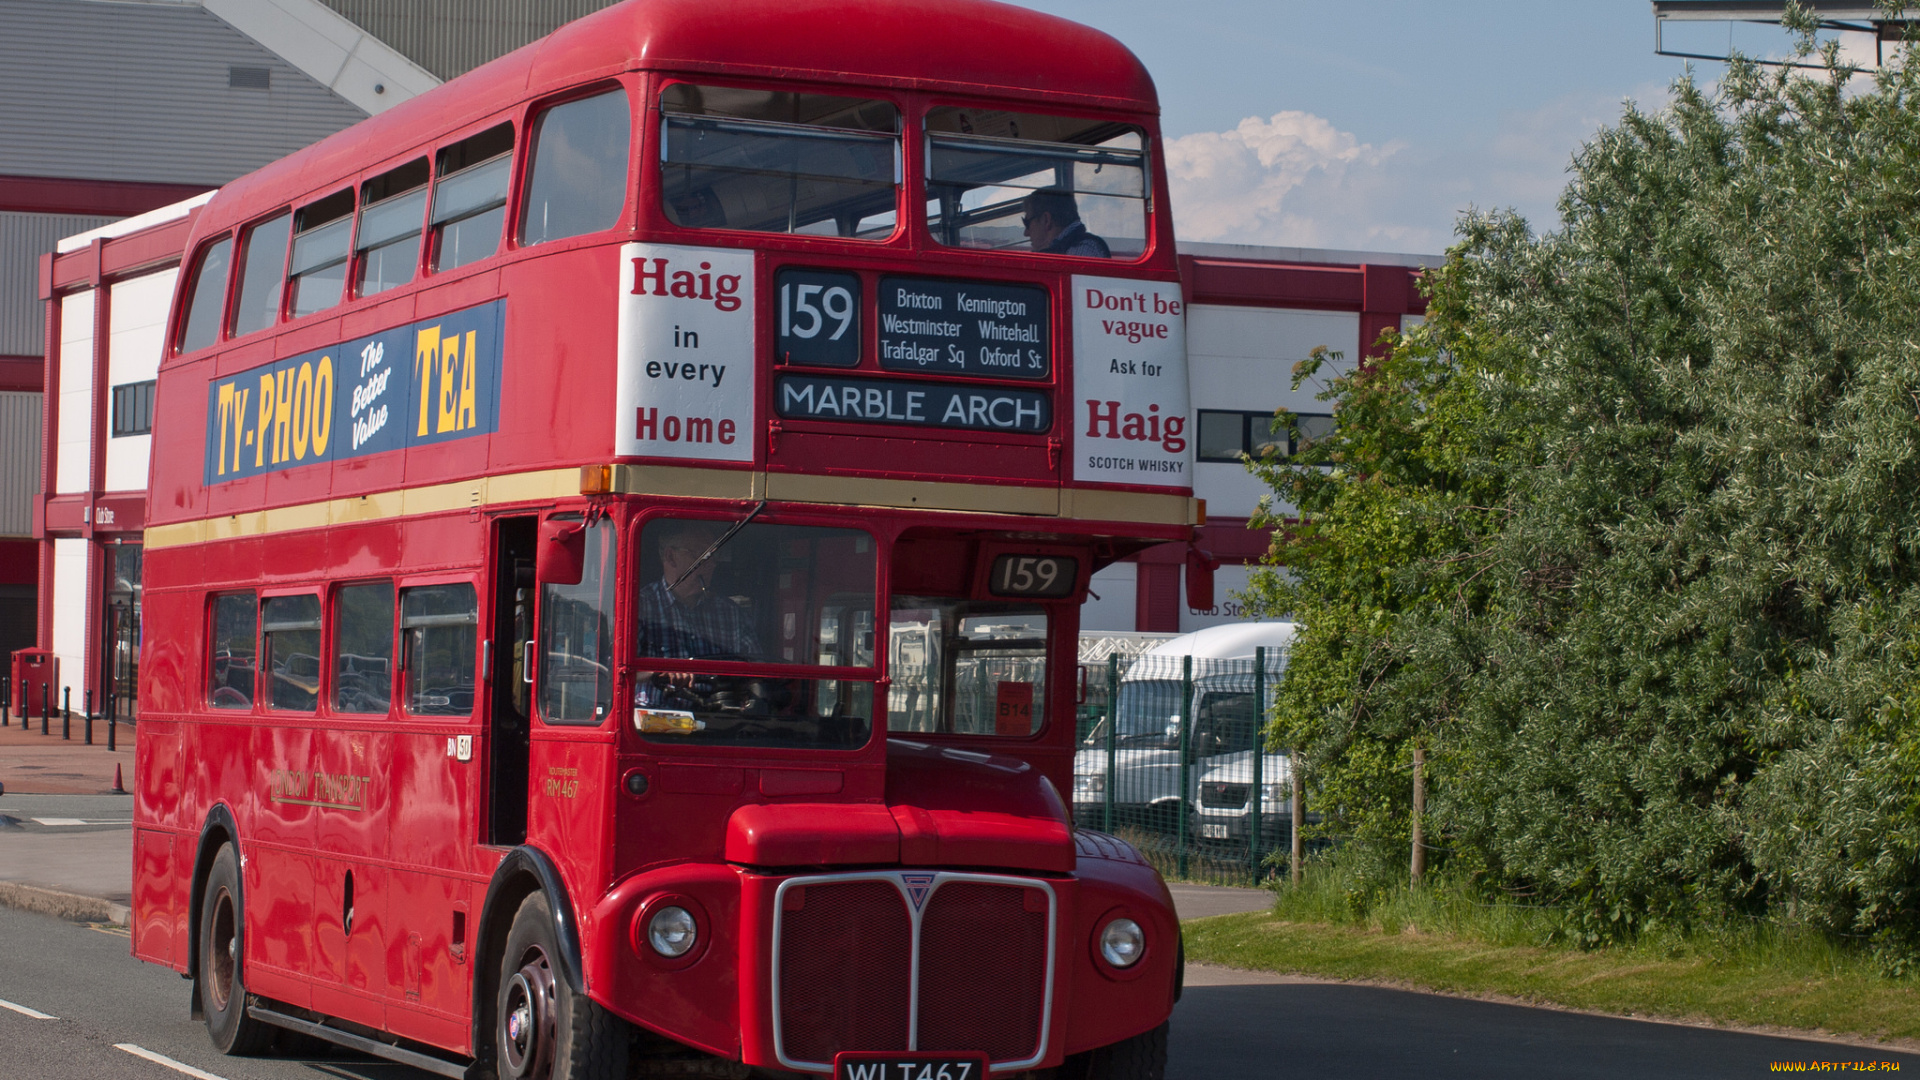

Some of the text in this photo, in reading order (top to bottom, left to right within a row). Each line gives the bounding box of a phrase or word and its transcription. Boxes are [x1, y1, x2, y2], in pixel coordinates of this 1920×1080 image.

[630, 257, 742, 312] Haig
[781, 283, 853, 340] 159
[897, 288, 1026, 319] Brixton Kennington
[1086, 289, 1181, 315] Don't be
[674, 325, 698, 348] in
[882, 314, 1040, 343] Westminster Whitehall
[1102, 320, 1168, 344] vague
[361, 340, 384, 378] The
[881, 340, 1042, 369] Trafalgar Sq Oxford St
[1110, 359, 1162, 377] Ask for
[415, 324, 477, 437] TEA
[646, 361, 726, 388] every
[351, 367, 392, 418] Better
[783, 383, 1041, 428] MARBLE ARCH
[217, 355, 333, 476] TY-PHOO
[352, 404, 389, 450] Value
[636, 407, 736, 445] Home
[1085, 399, 1186, 453] Haig
[1089, 456, 1184, 473] SCOTCH WHISKY
[1003, 558, 1058, 591] 159
[1000, 703, 1029, 717] B14
[447, 737, 470, 756] BN 50
[270, 768, 370, 812] LONDON TRANSPORT
[546, 778, 579, 799] RM 467
